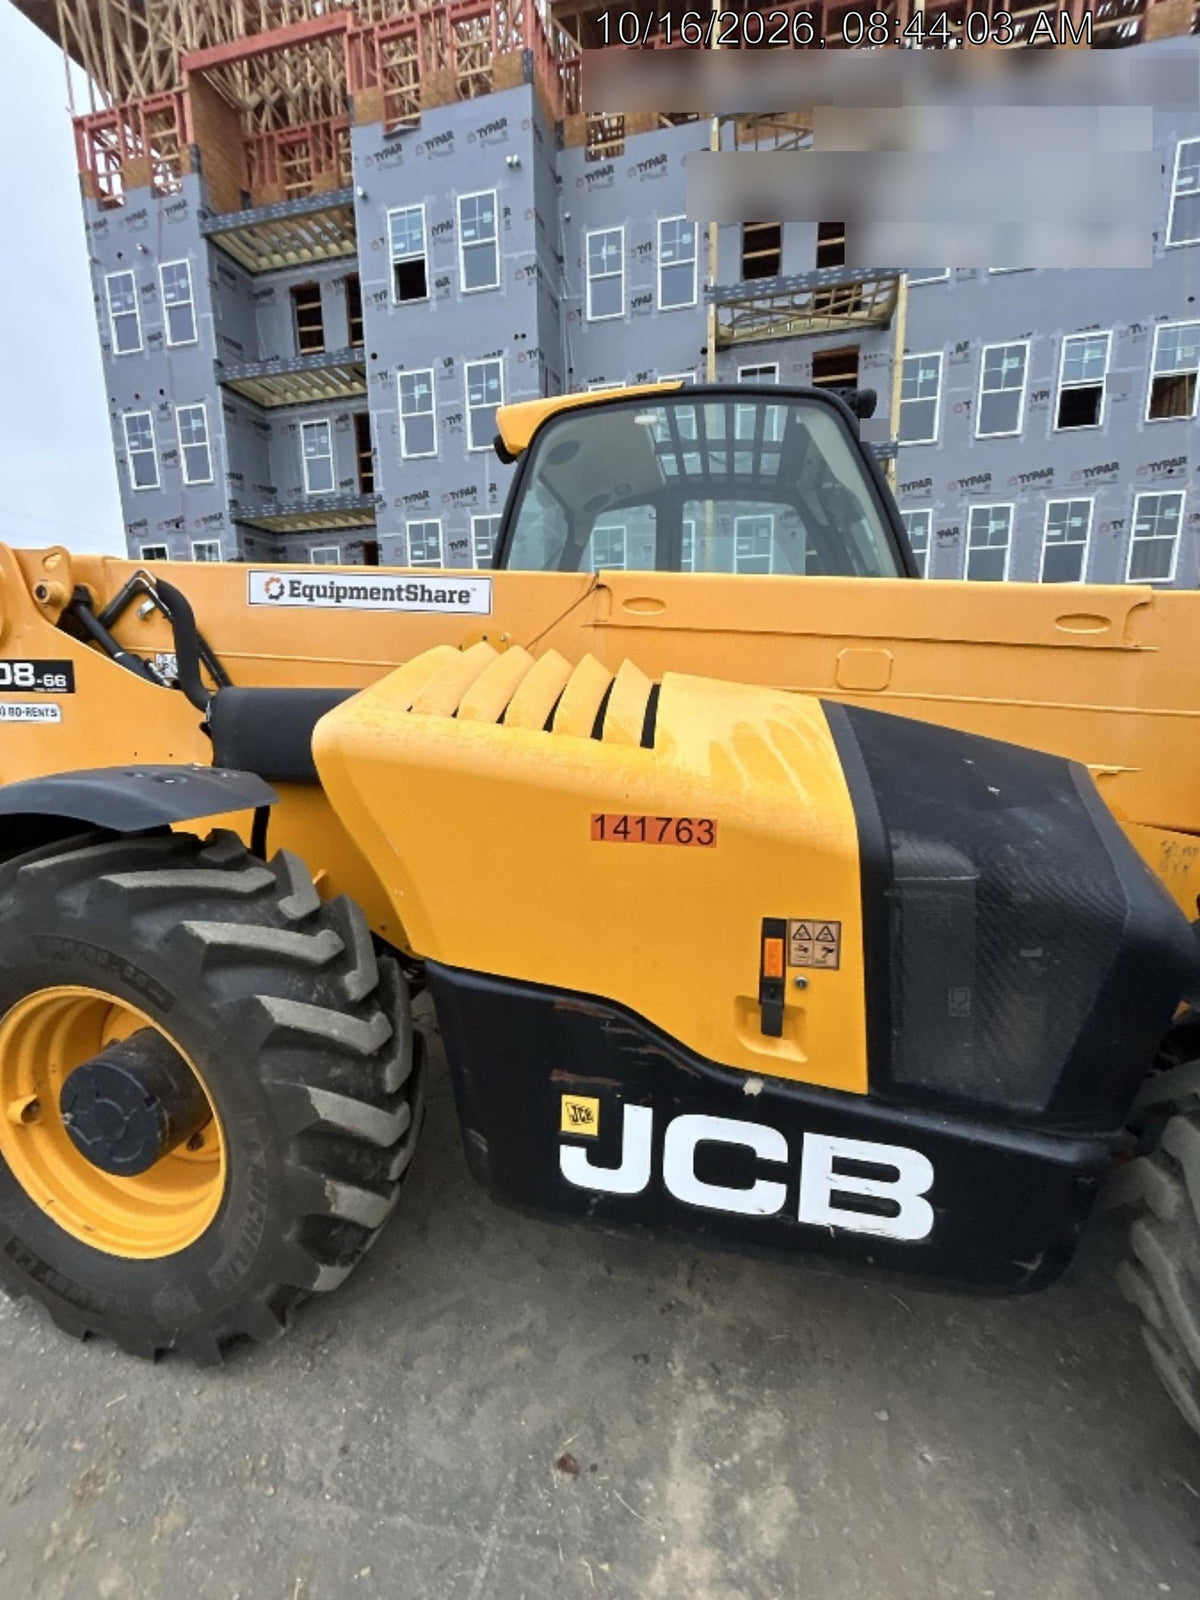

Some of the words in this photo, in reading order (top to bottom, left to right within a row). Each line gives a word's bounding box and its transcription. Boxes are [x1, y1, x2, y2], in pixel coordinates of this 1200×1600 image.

[476, 117, 508, 138] TYPAR
[424, 130, 455, 151] TYPAR
[373, 143, 403, 162] TYPAR
[636, 153, 668, 173] TYPAR
[584, 164, 615, 184] TYPAR
[1083, 462, 1119, 479] TYPAR
[1147, 456, 1187, 473] TYPAR
[957, 472, 992, 489] TYPAR
[1018, 467, 1054, 484] TYPAR
[449, 485, 477, 500] TYPAR
[900, 478, 933, 493] TYPAR
[402, 490, 430, 504] TYPAR
[937, 527, 960, 539] PAR
[594, 813, 715, 846] 141763
[559, 1103, 934, 1241] JCB
